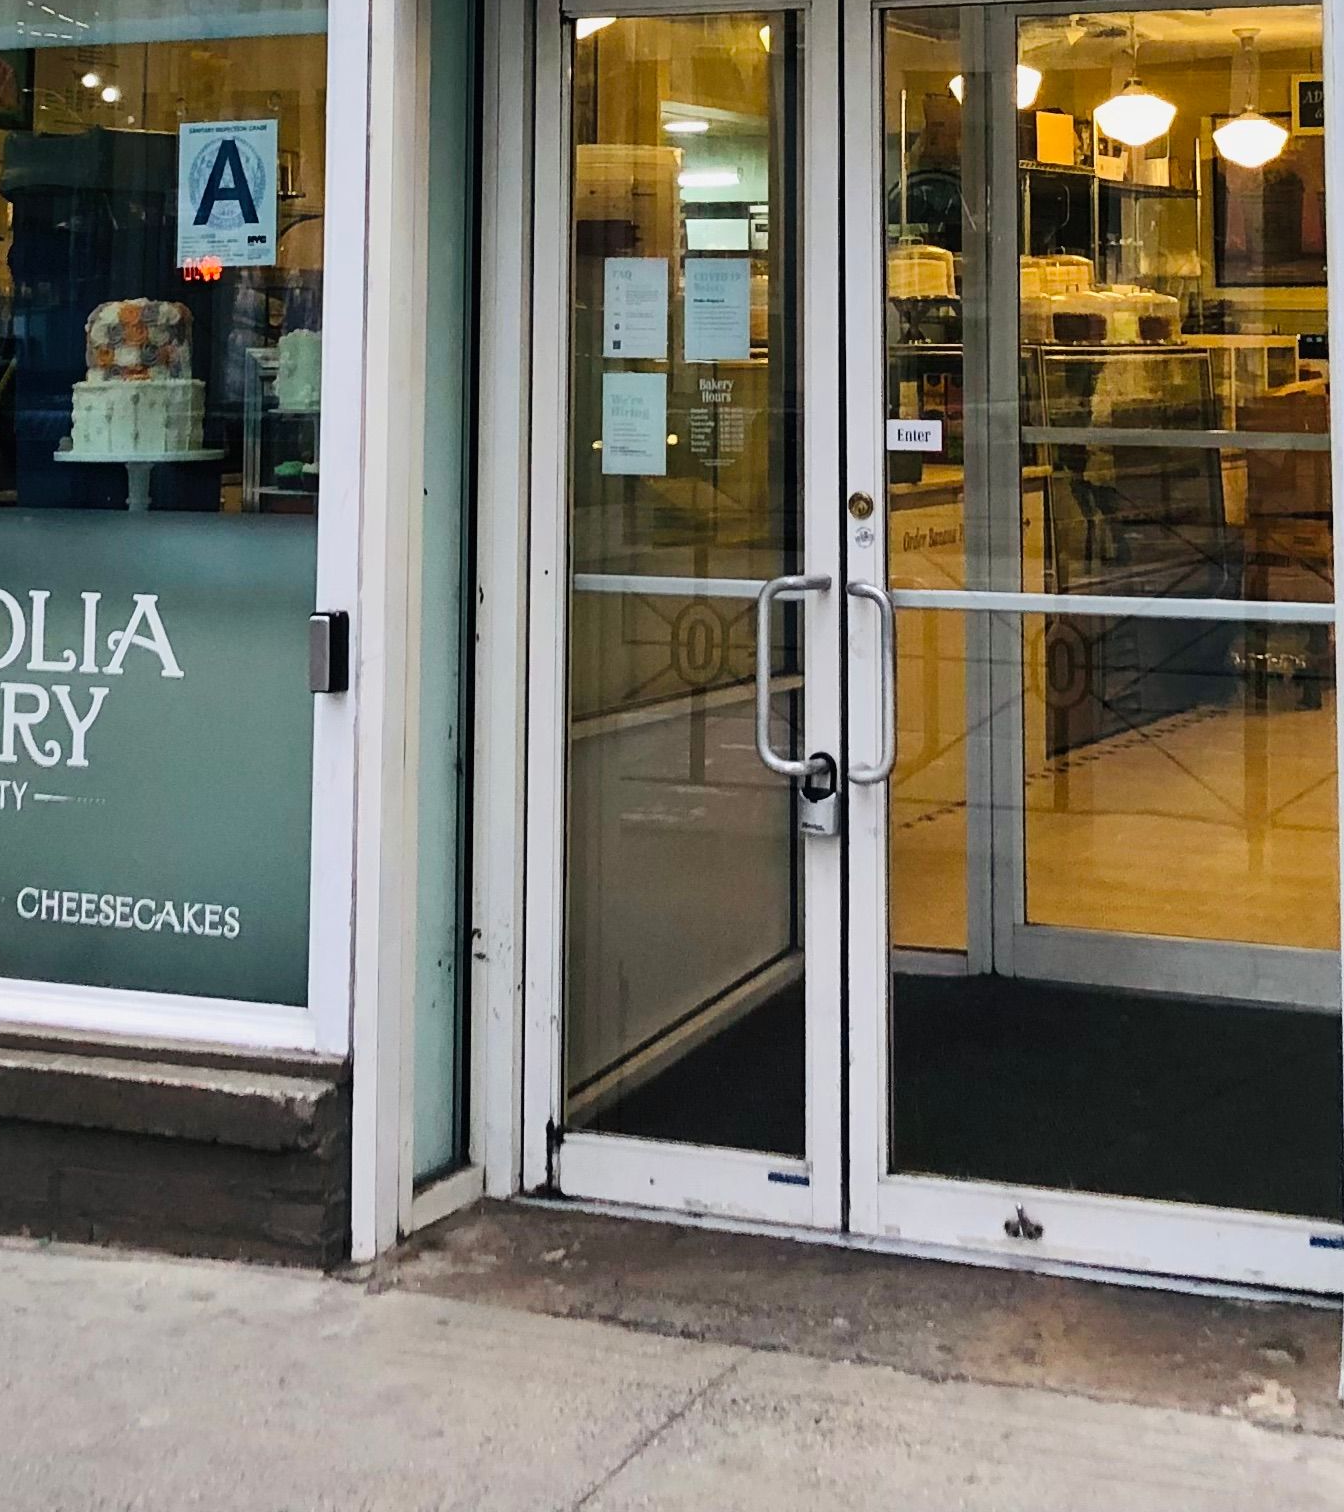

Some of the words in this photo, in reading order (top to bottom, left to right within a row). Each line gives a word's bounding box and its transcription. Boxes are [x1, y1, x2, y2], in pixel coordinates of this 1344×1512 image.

[193, 139, 260, 226] A
[699, 378, 734, 392] Bakery
[701, 390, 732, 403] Hours
[897, 428, 931, 443] Enter
[903, 527, 928, 552] Order
[15, 886, 242, 940] CHEESECAKES
